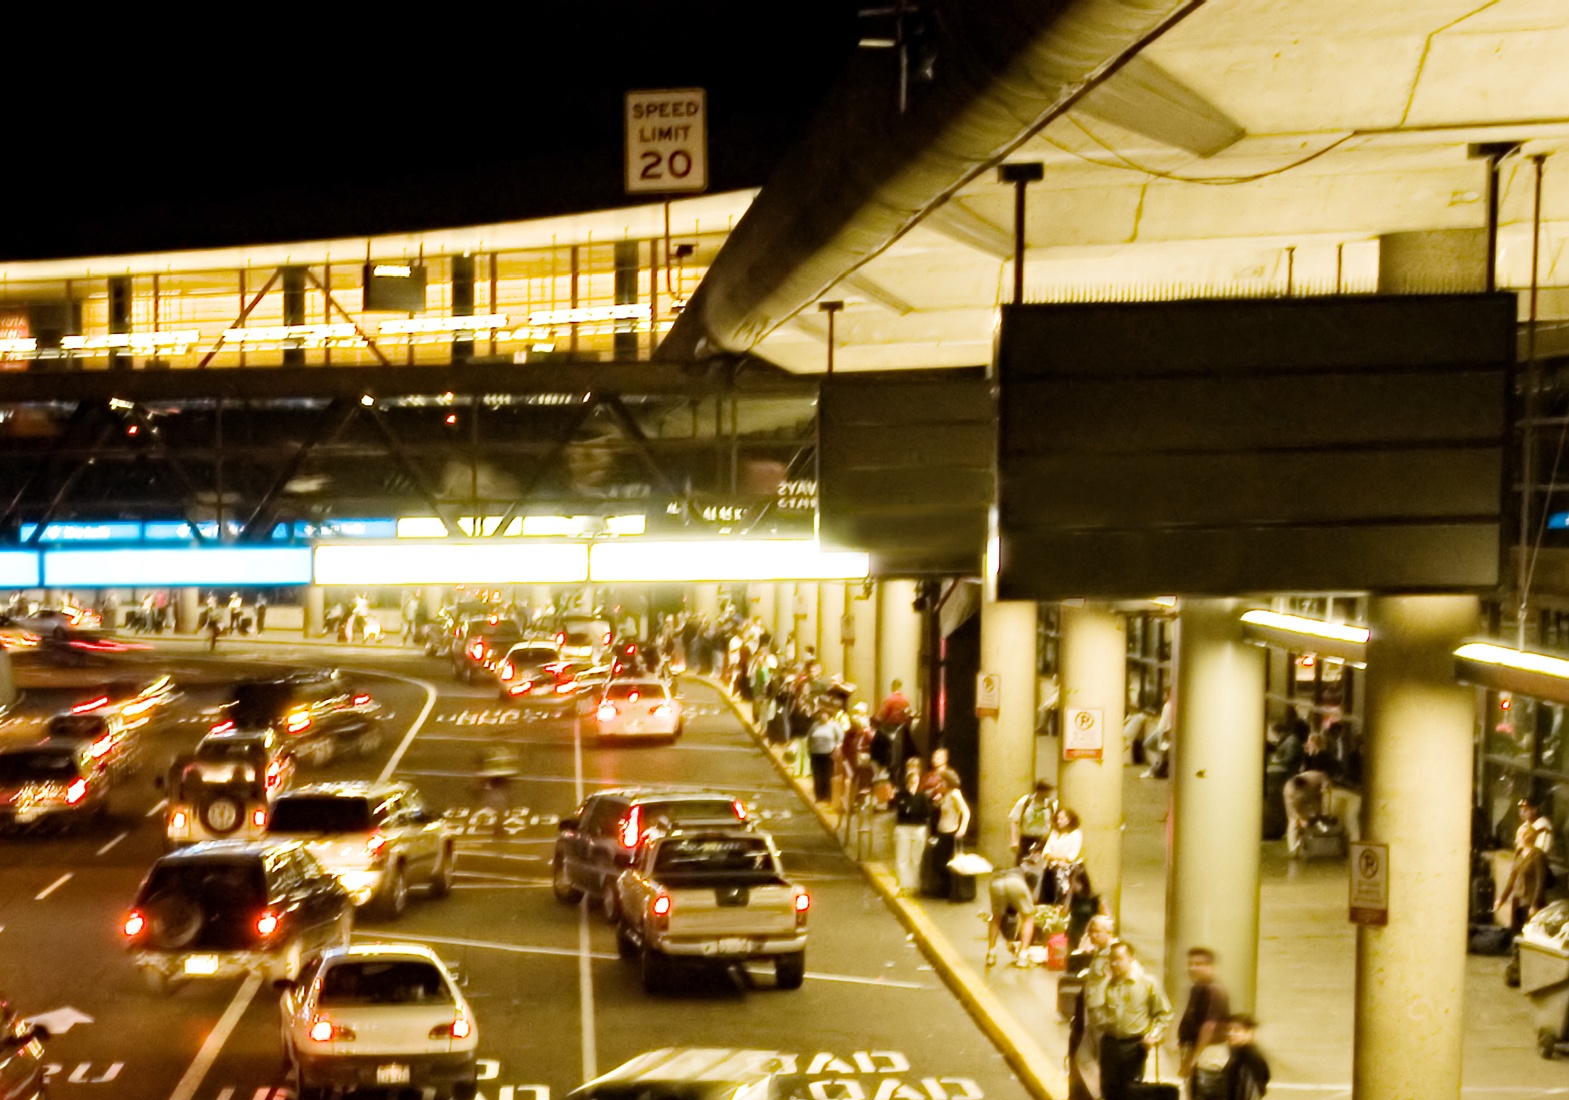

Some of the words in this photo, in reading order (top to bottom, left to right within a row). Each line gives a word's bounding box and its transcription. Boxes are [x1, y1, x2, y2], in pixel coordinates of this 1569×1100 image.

[632, 101, 699, 119] SPEED
[639, 125, 692, 142] LIMIT
[639, 149, 692, 179] 20
